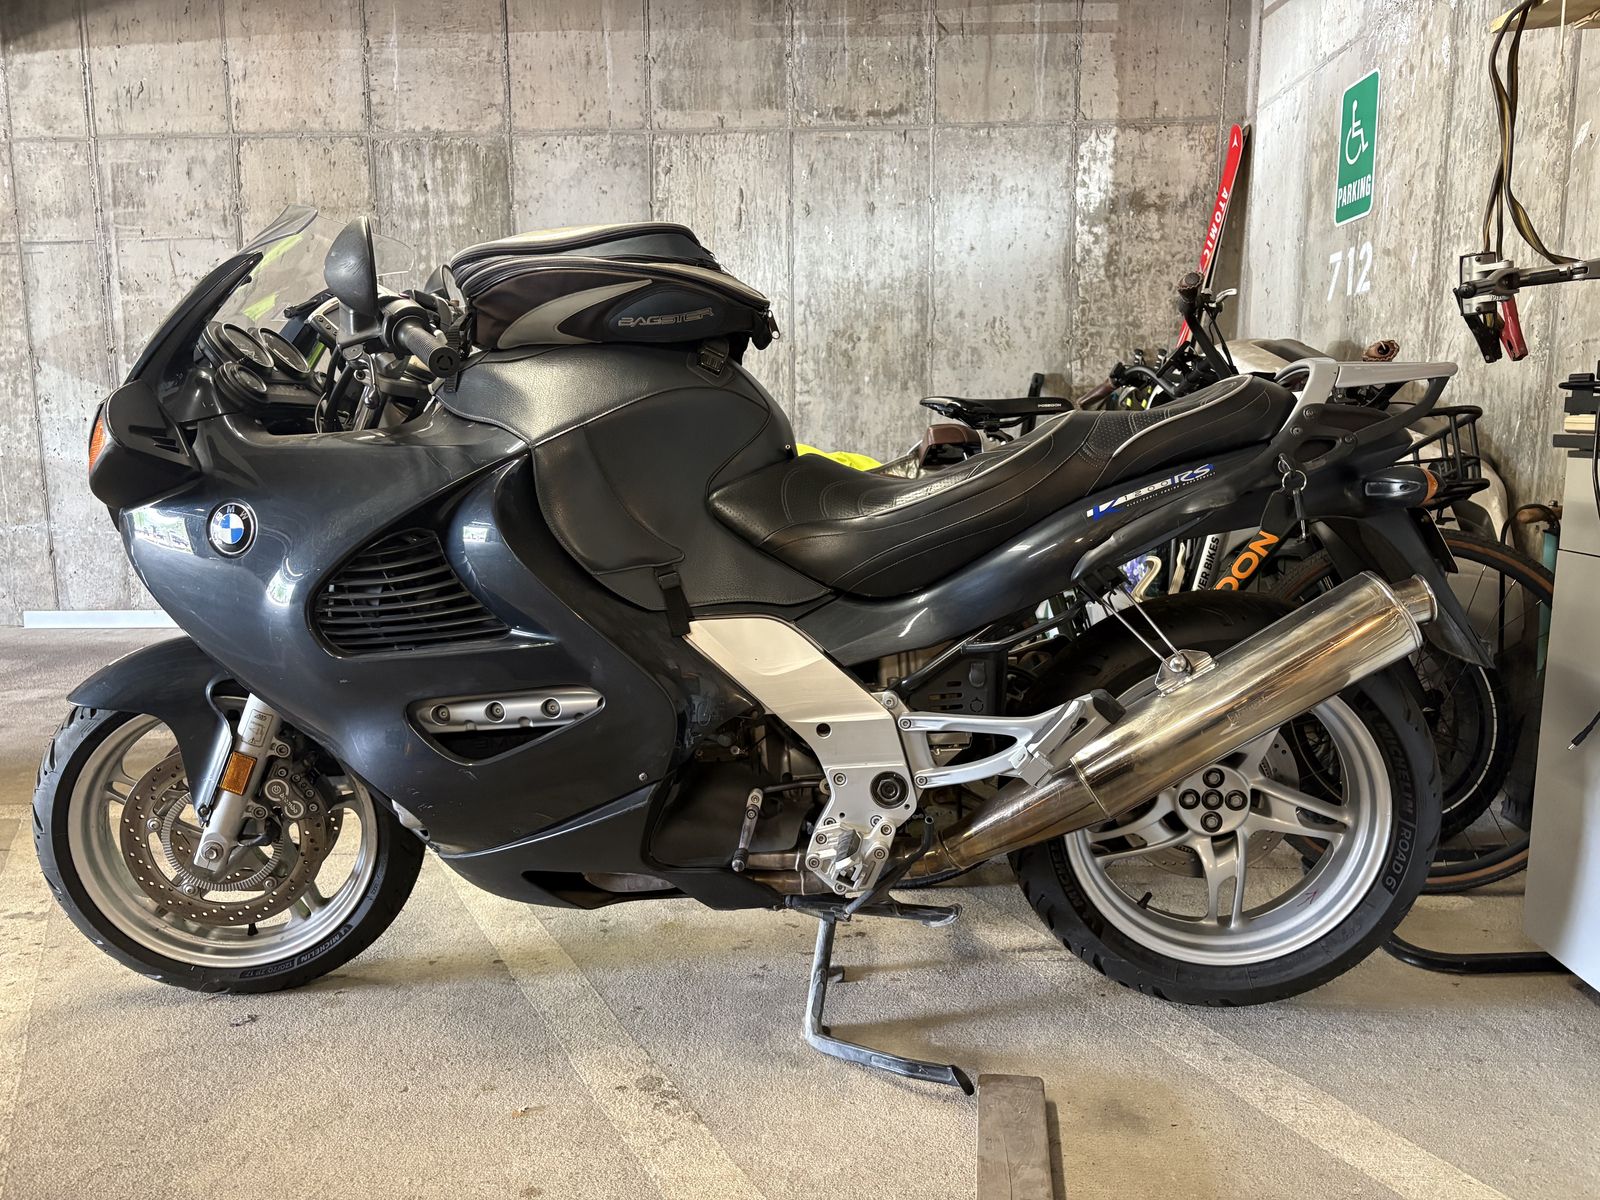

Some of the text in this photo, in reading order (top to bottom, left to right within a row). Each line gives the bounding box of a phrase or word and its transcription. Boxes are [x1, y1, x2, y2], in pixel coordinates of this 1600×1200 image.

[1337, 174, 1372, 209] PARKING
[1203, 186, 1229, 260] ATOMIC
[1327, 240, 1373, 302] 712
[618, 307, 715, 328] BAGSTER
[1205, 536, 1220, 571] BIKES
[1376, 721, 1414, 890] MICHELIN ROAD 6
[301, 935, 341, 963] MICHELIN
